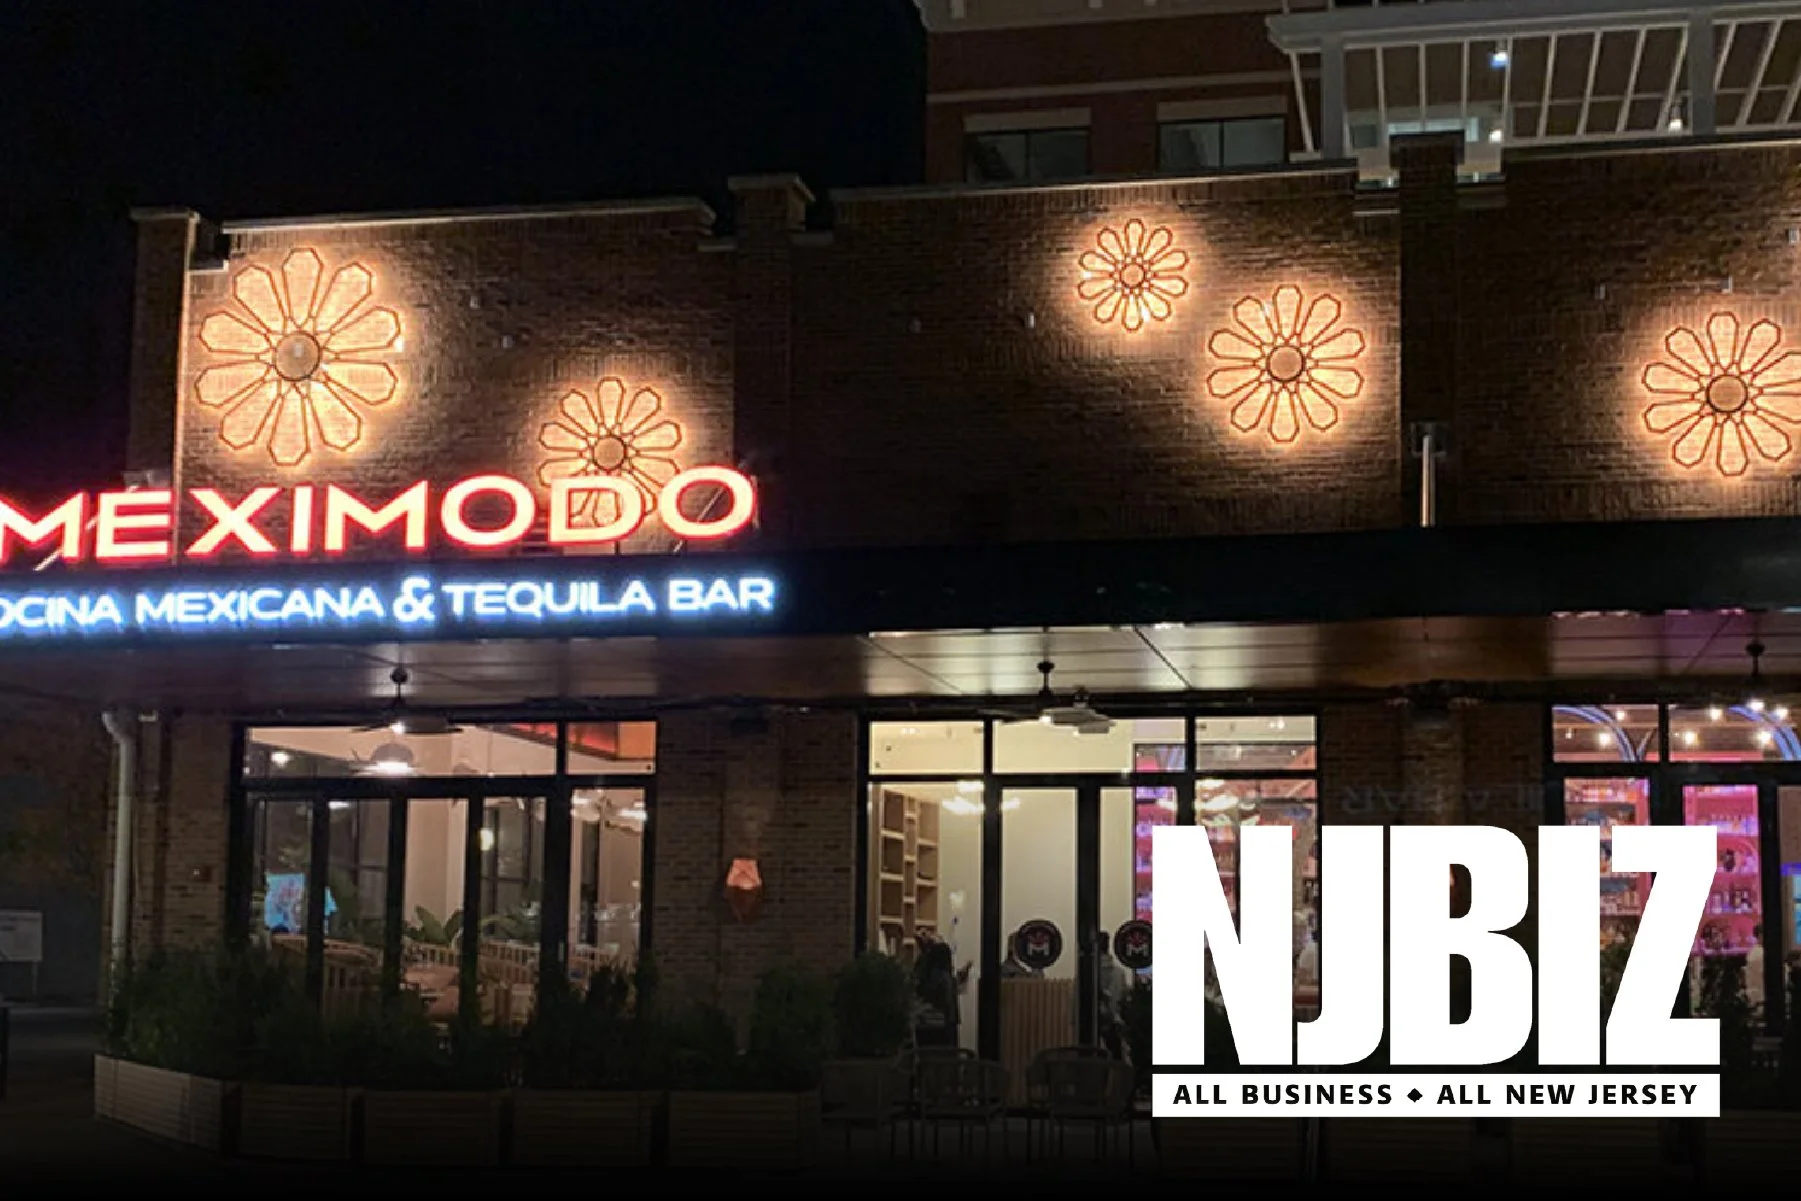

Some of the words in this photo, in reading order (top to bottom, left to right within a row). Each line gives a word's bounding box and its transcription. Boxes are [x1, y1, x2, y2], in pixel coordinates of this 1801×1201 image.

[0, 464, 756, 561] MEXIMODO
[135, 586, 385, 624] MEXICANA
[392, 577, 435, 622] &
[441, 580, 656, 618] TEQUILA
[668, 578, 774, 612] BAR
